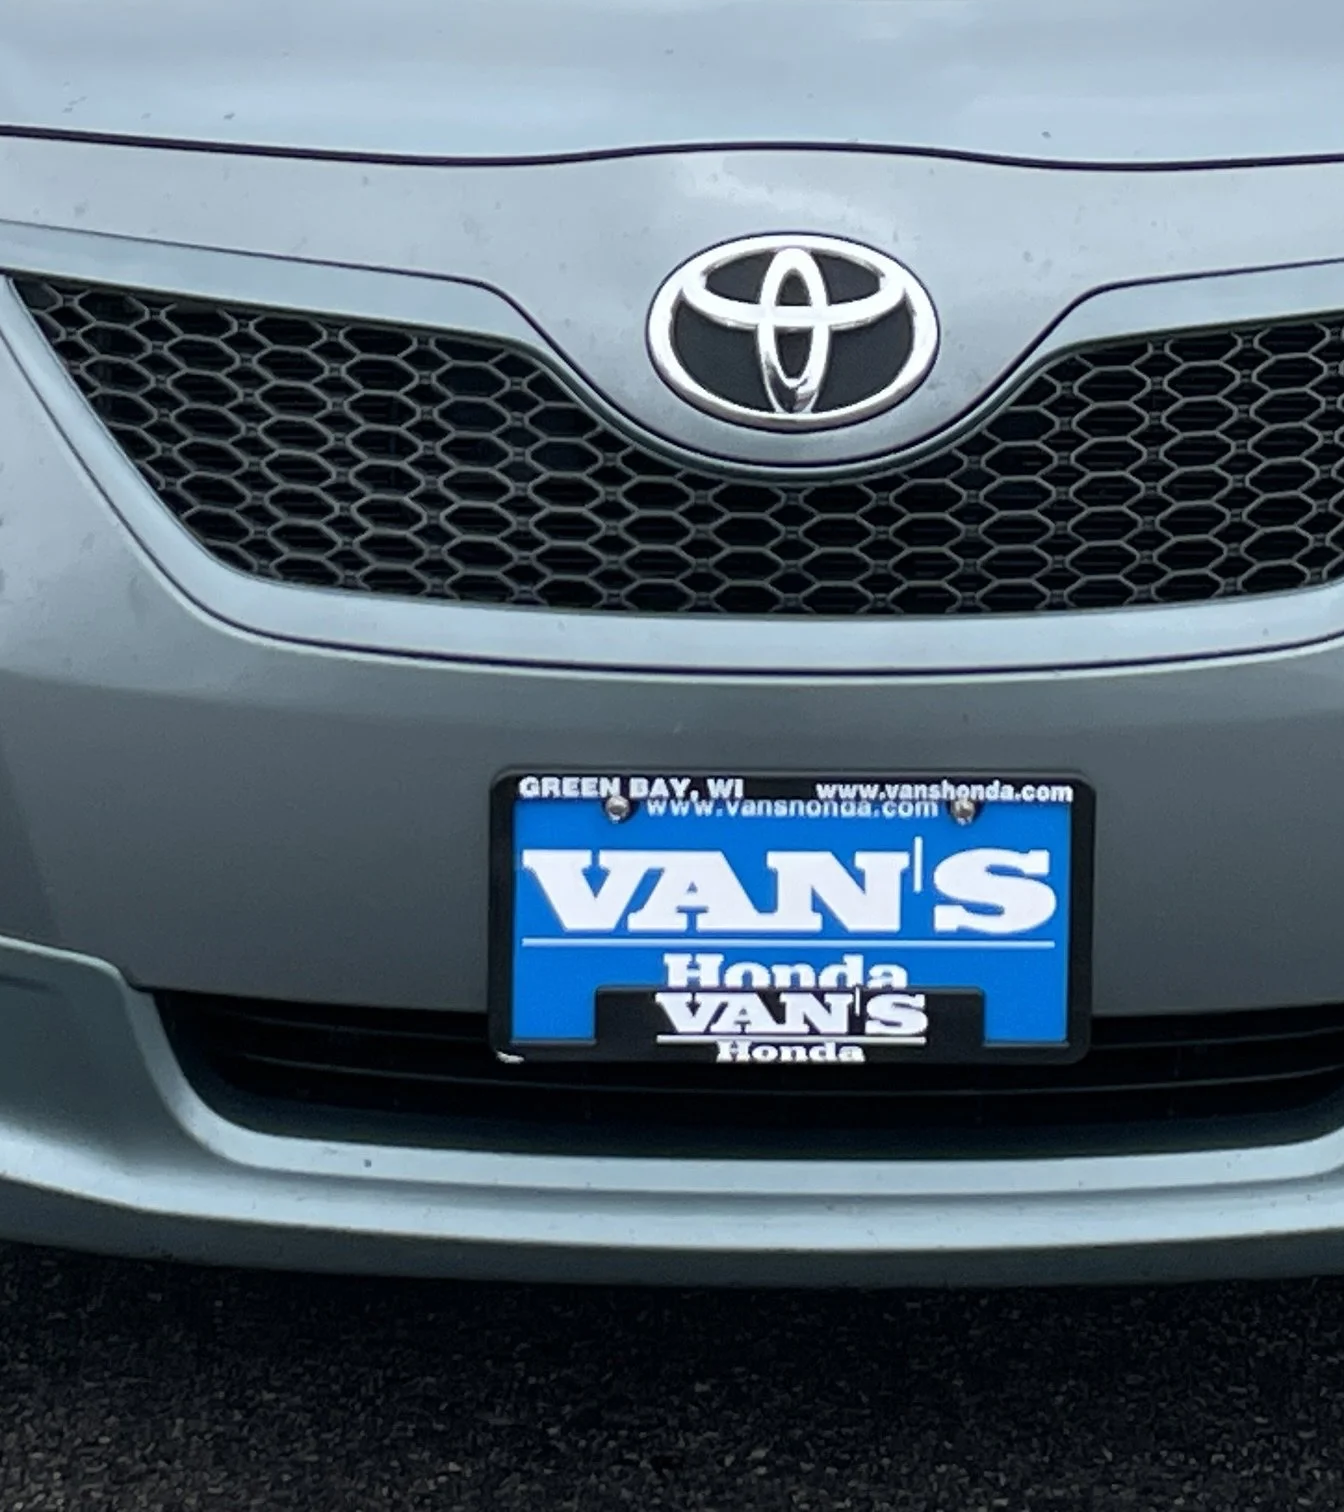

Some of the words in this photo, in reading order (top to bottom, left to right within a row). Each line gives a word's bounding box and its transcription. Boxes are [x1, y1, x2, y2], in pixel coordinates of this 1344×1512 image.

[519, 776, 621, 799] GREEN
[629, 777, 699, 802] BAY,
[707, 778, 744, 799] WI
[815, 779, 1074, 803] www.vanshonda.com
[522, 836, 1057, 934] VAN'S
[663, 953, 909, 989] Honda
[655, 986, 929, 1036] VAN'S
[716, 1040, 866, 1063] Honda
